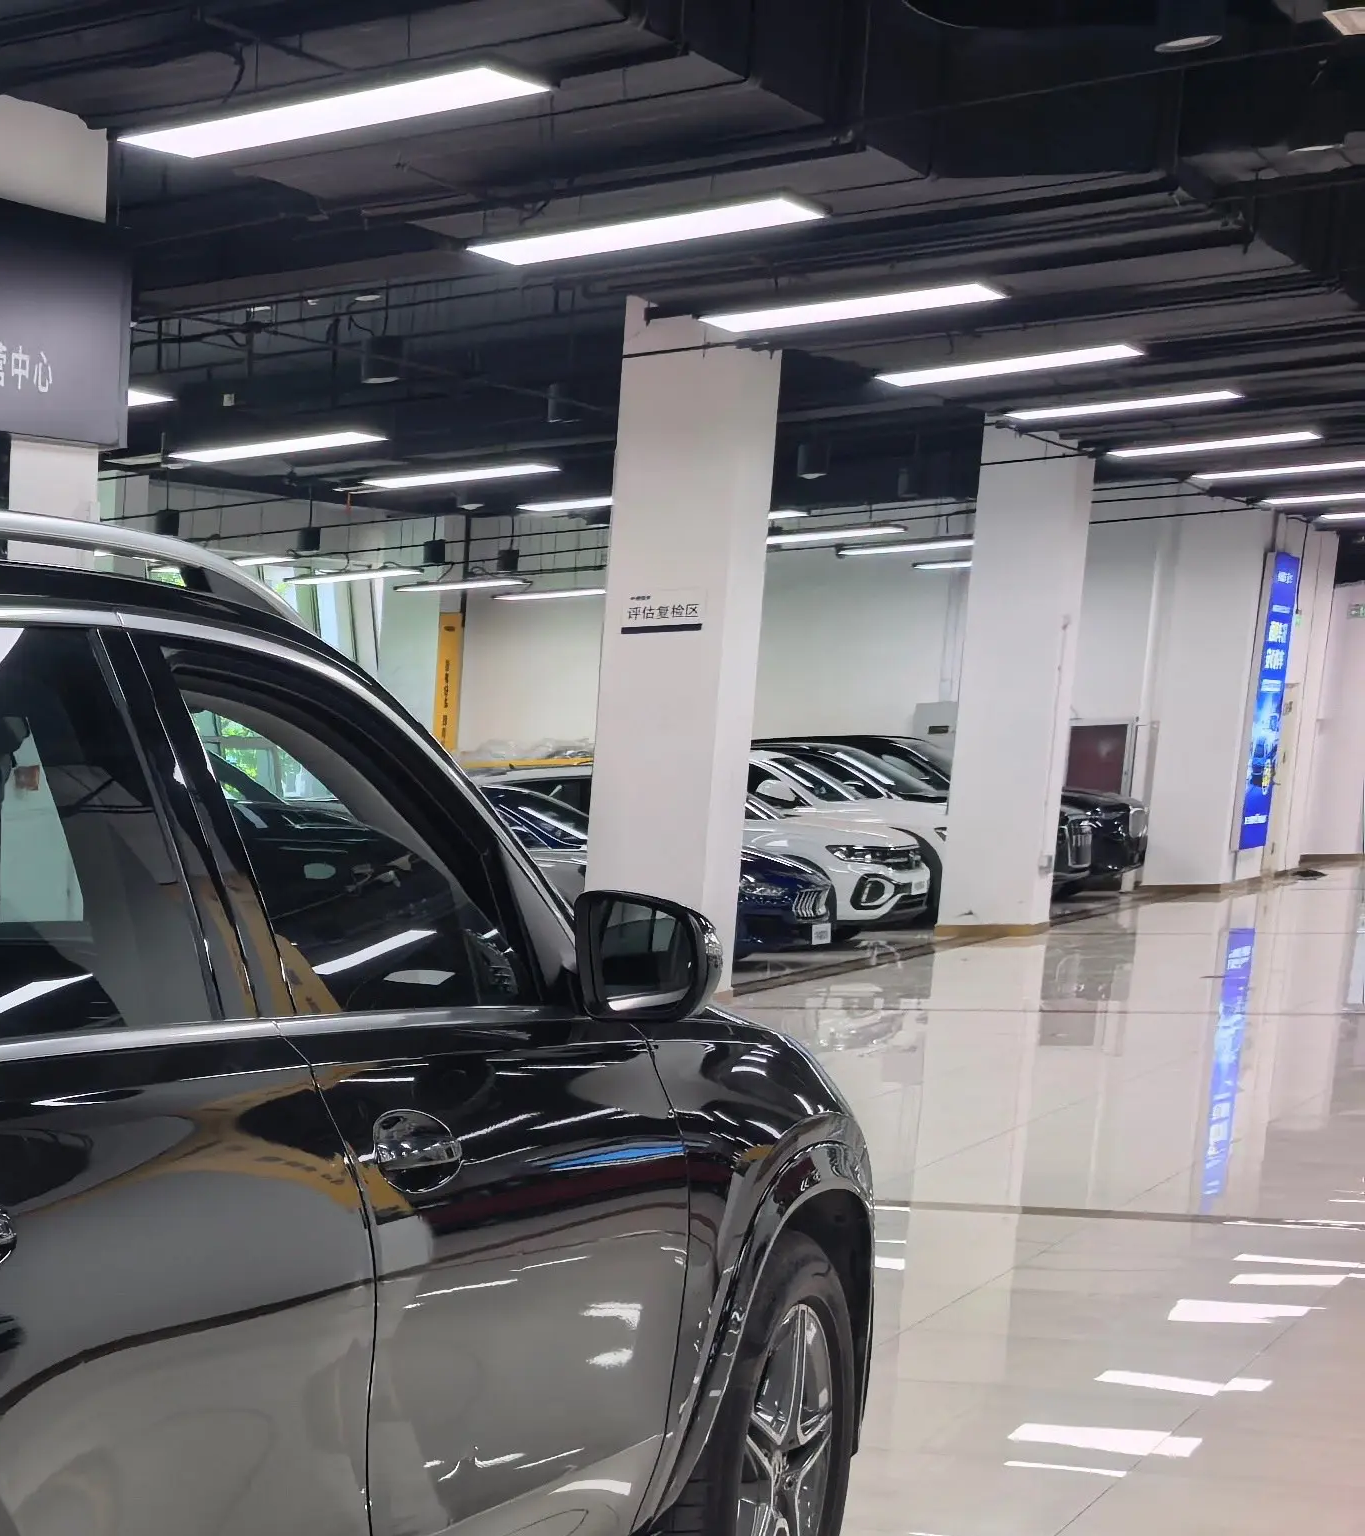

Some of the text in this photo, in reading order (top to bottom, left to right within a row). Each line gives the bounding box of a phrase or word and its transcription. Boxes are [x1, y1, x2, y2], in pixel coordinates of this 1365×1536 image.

[628, 603, 700, 620] 评估复检区
